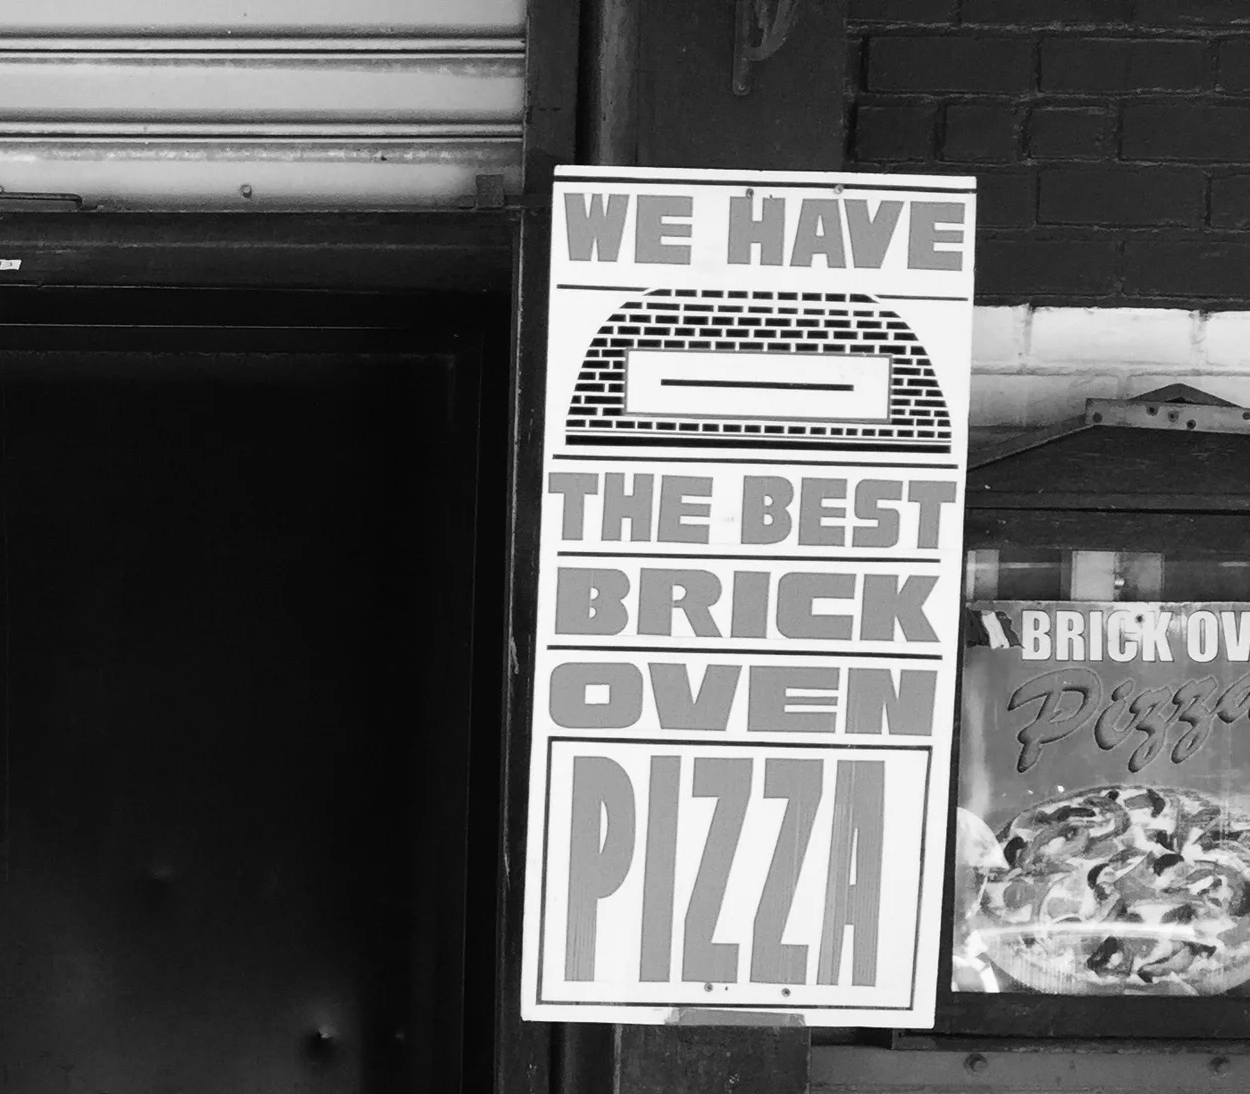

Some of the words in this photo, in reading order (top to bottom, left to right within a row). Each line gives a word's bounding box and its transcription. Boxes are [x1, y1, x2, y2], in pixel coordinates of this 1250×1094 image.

[563, 193, 694, 265] WE
[727, 196, 966, 271] HAVE
[548, 472, 714, 544] THE
[740, 475, 957, 549] BEST
[554, 567, 941, 643] BRICK
[1021, 609, 1175, 663] BRICK
[1186, 610, 1250, 663] OV
[548, 662, 938, 736] OVEN
[564, 755, 886, 986] PIZZA
